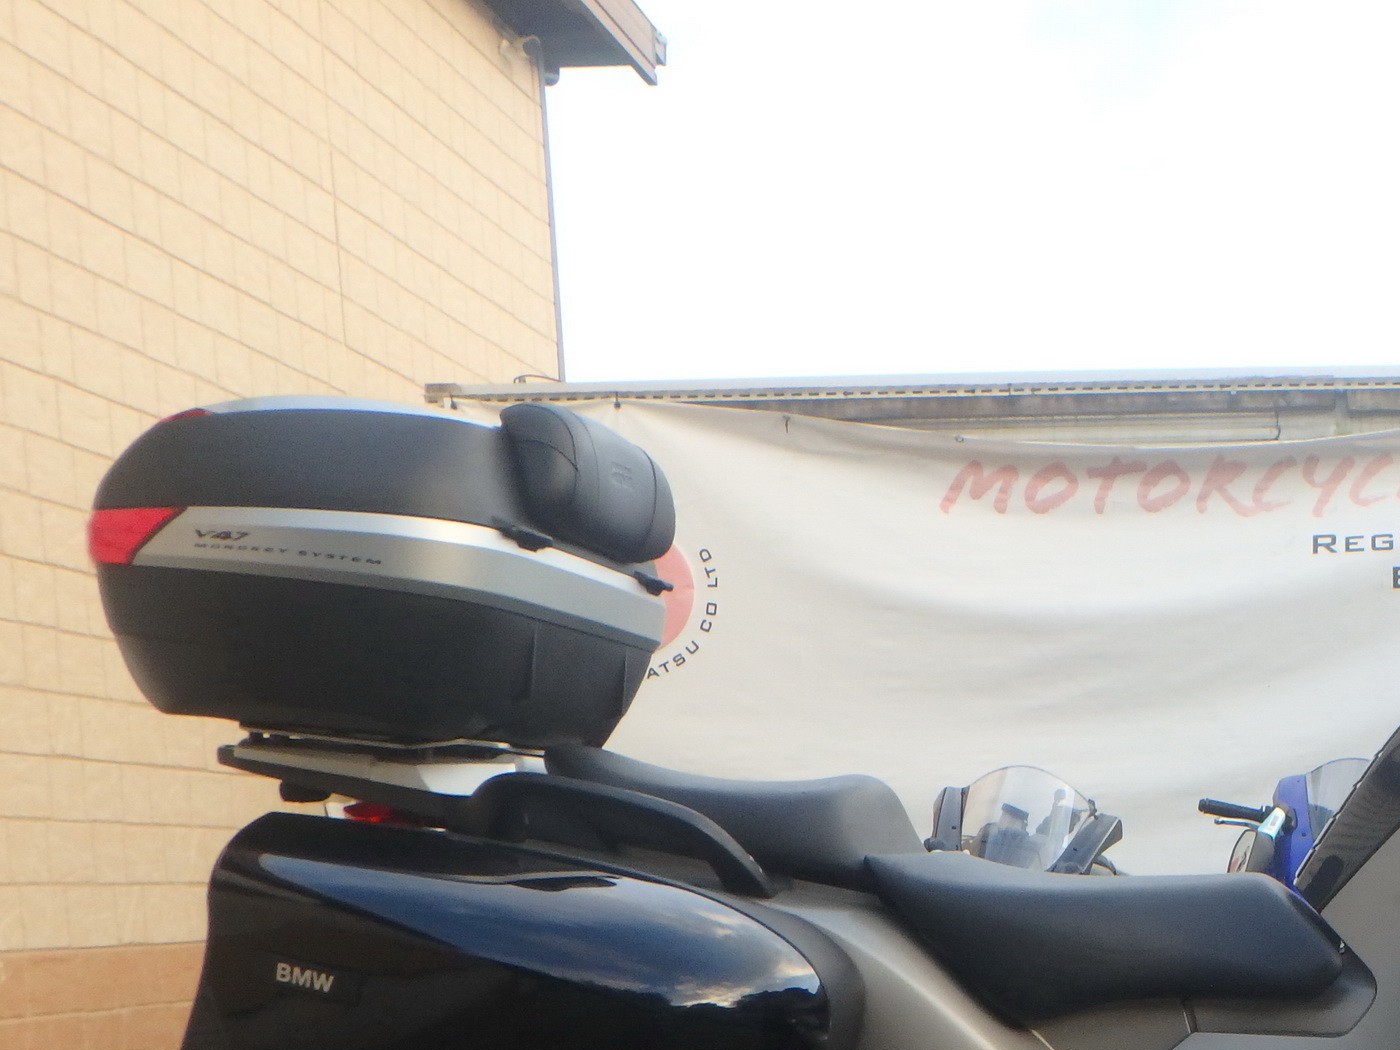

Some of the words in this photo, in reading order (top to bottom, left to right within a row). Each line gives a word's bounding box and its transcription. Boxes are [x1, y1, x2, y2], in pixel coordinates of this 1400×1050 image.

[195, 528, 250, 541] V47
[699, 548, 718, 588] LTD
[699, 602, 718, 633] CO
[275, 962, 334, 993] BMW
